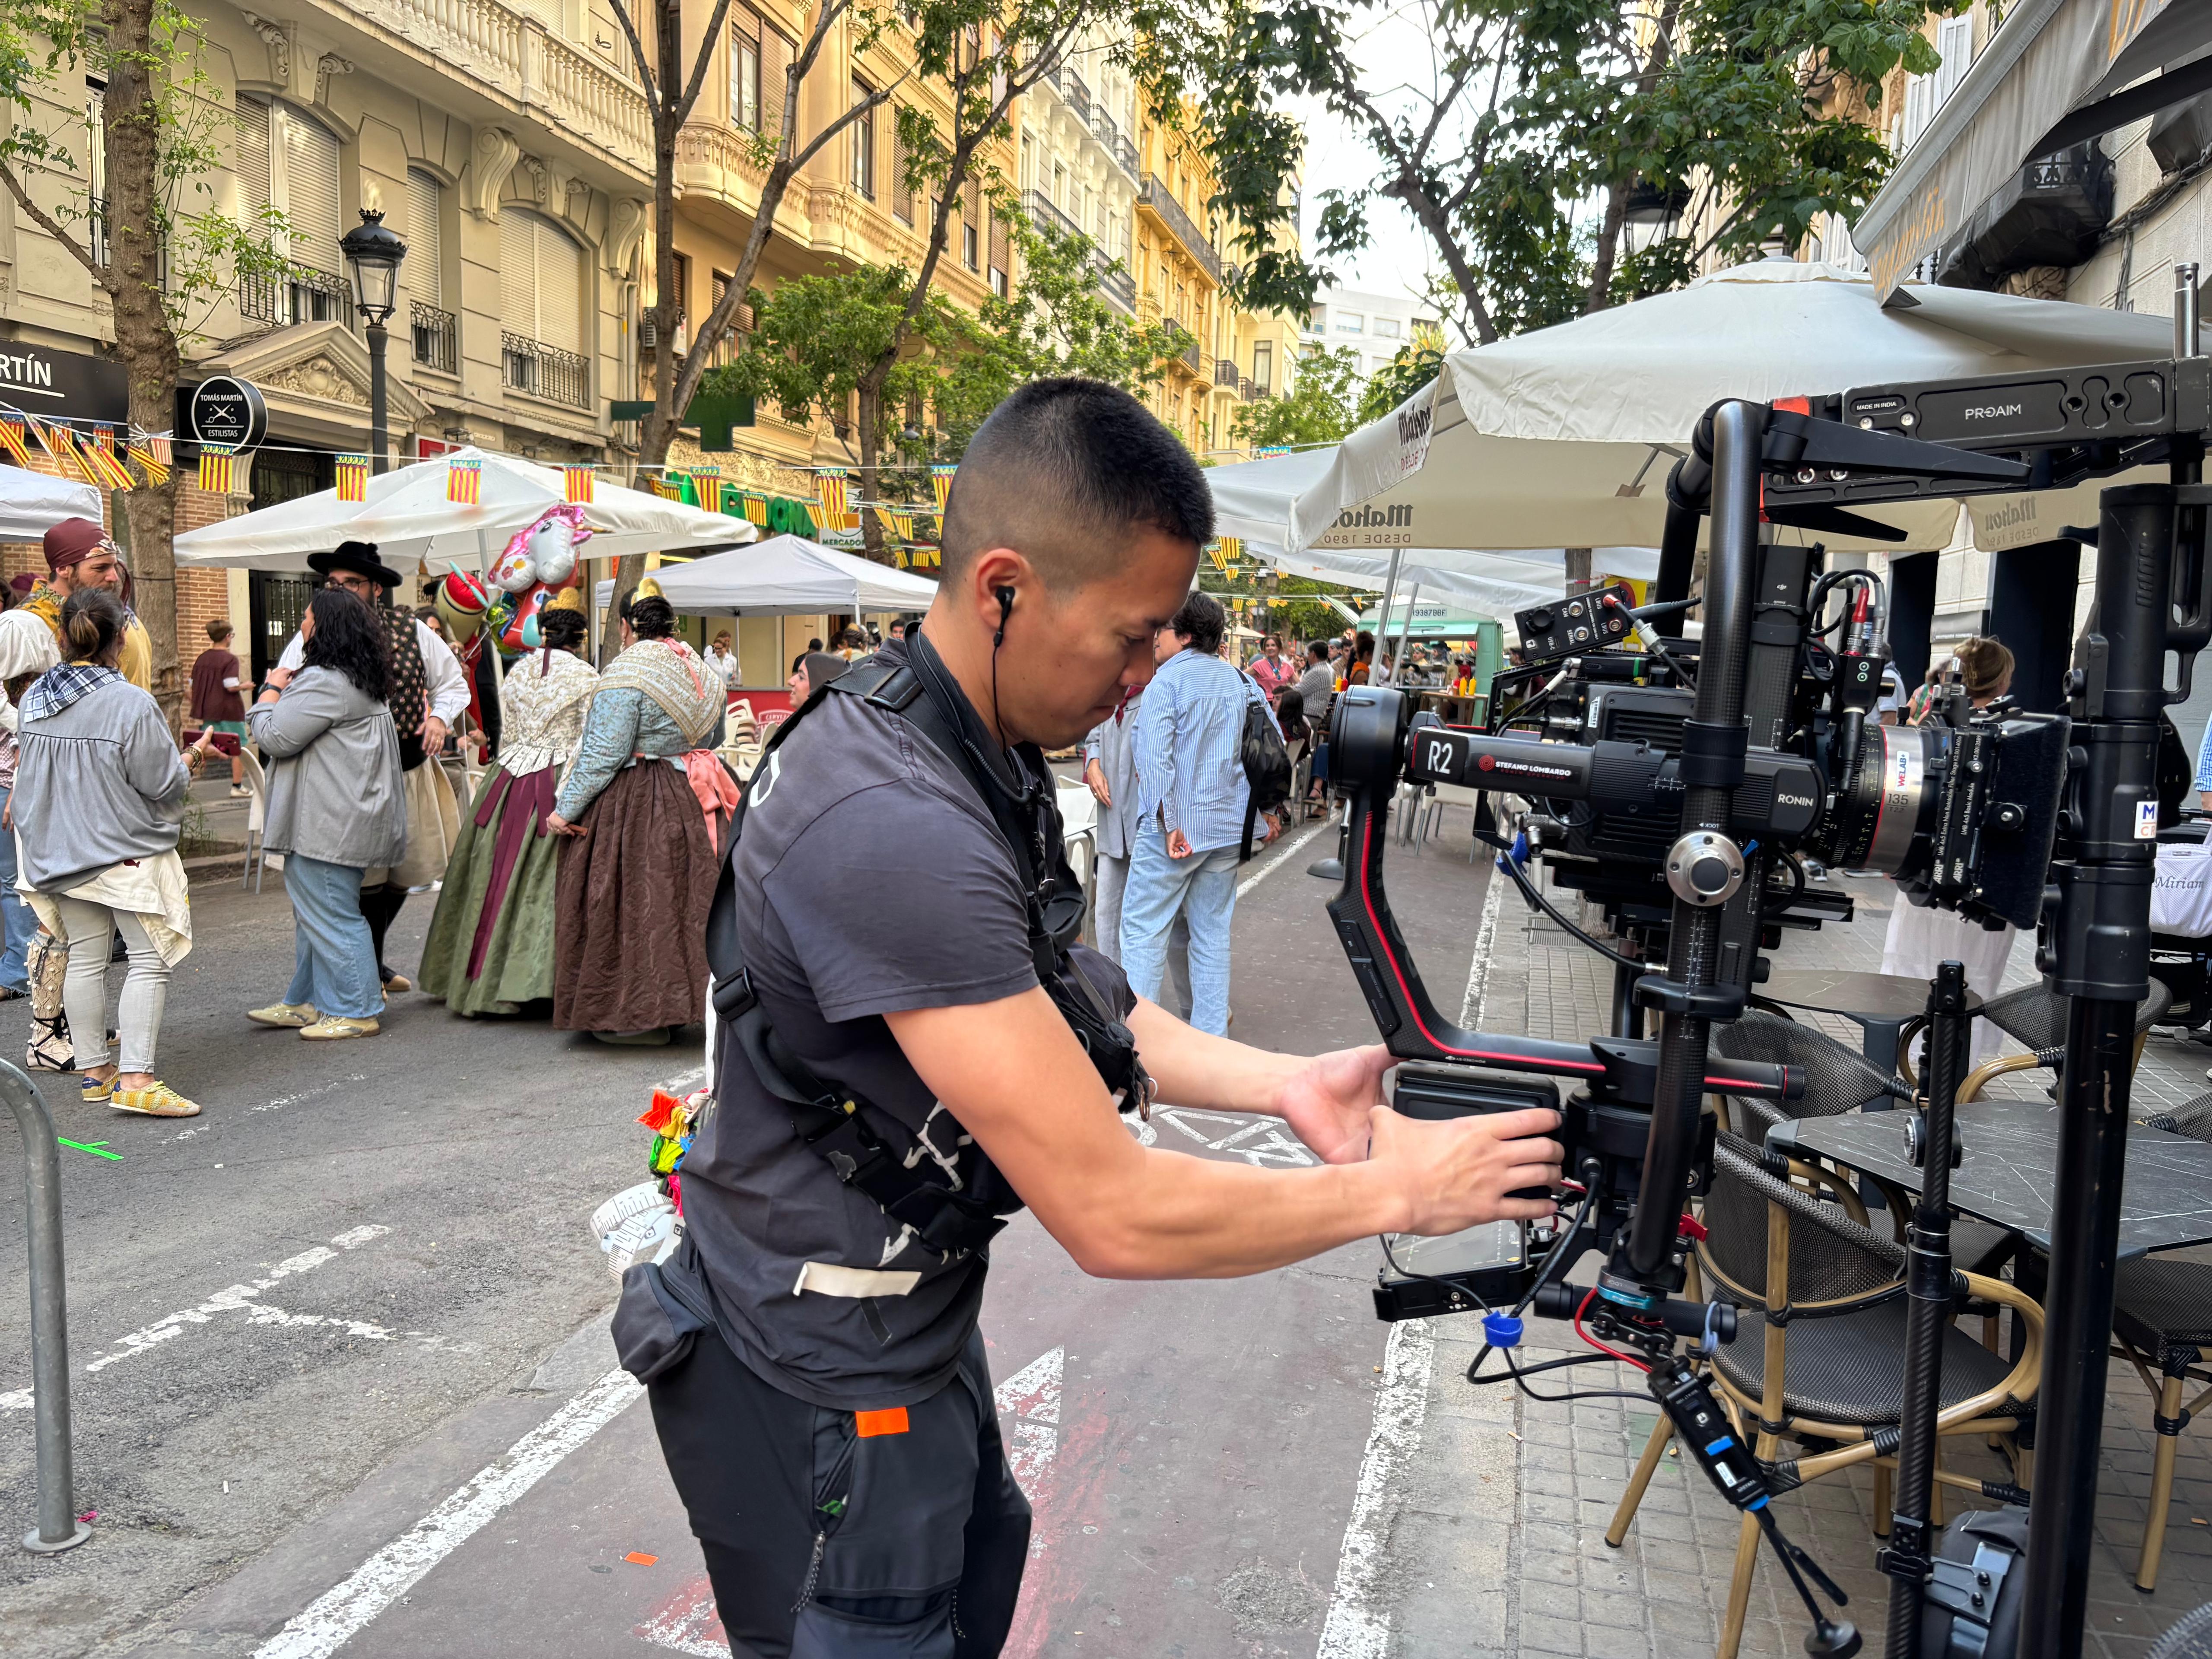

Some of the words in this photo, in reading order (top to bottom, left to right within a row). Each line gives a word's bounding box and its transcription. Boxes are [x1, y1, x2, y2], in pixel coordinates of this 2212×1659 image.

[0, 353, 51, 386] RTÍN
[200, 393, 220, 401] TOMÁS
[220, 393, 243, 401] MARTÍN
[1965, 404, 2022, 420] PROAIM
[1398, 403, 1432, 446] Maho
[1427, 741, 1452, 774] R2
[1495, 761, 1529, 771] STEFANO
[1529, 765, 1572, 776] LOMBARDO
[1897, 754, 1907, 787] WELAB+
[1888, 794, 1908, 805] 135
[1967, 783, 1975, 801] Module
[1777, 794, 1814, 807] RONIN
[2155, 875, 2204, 890] Miriam
